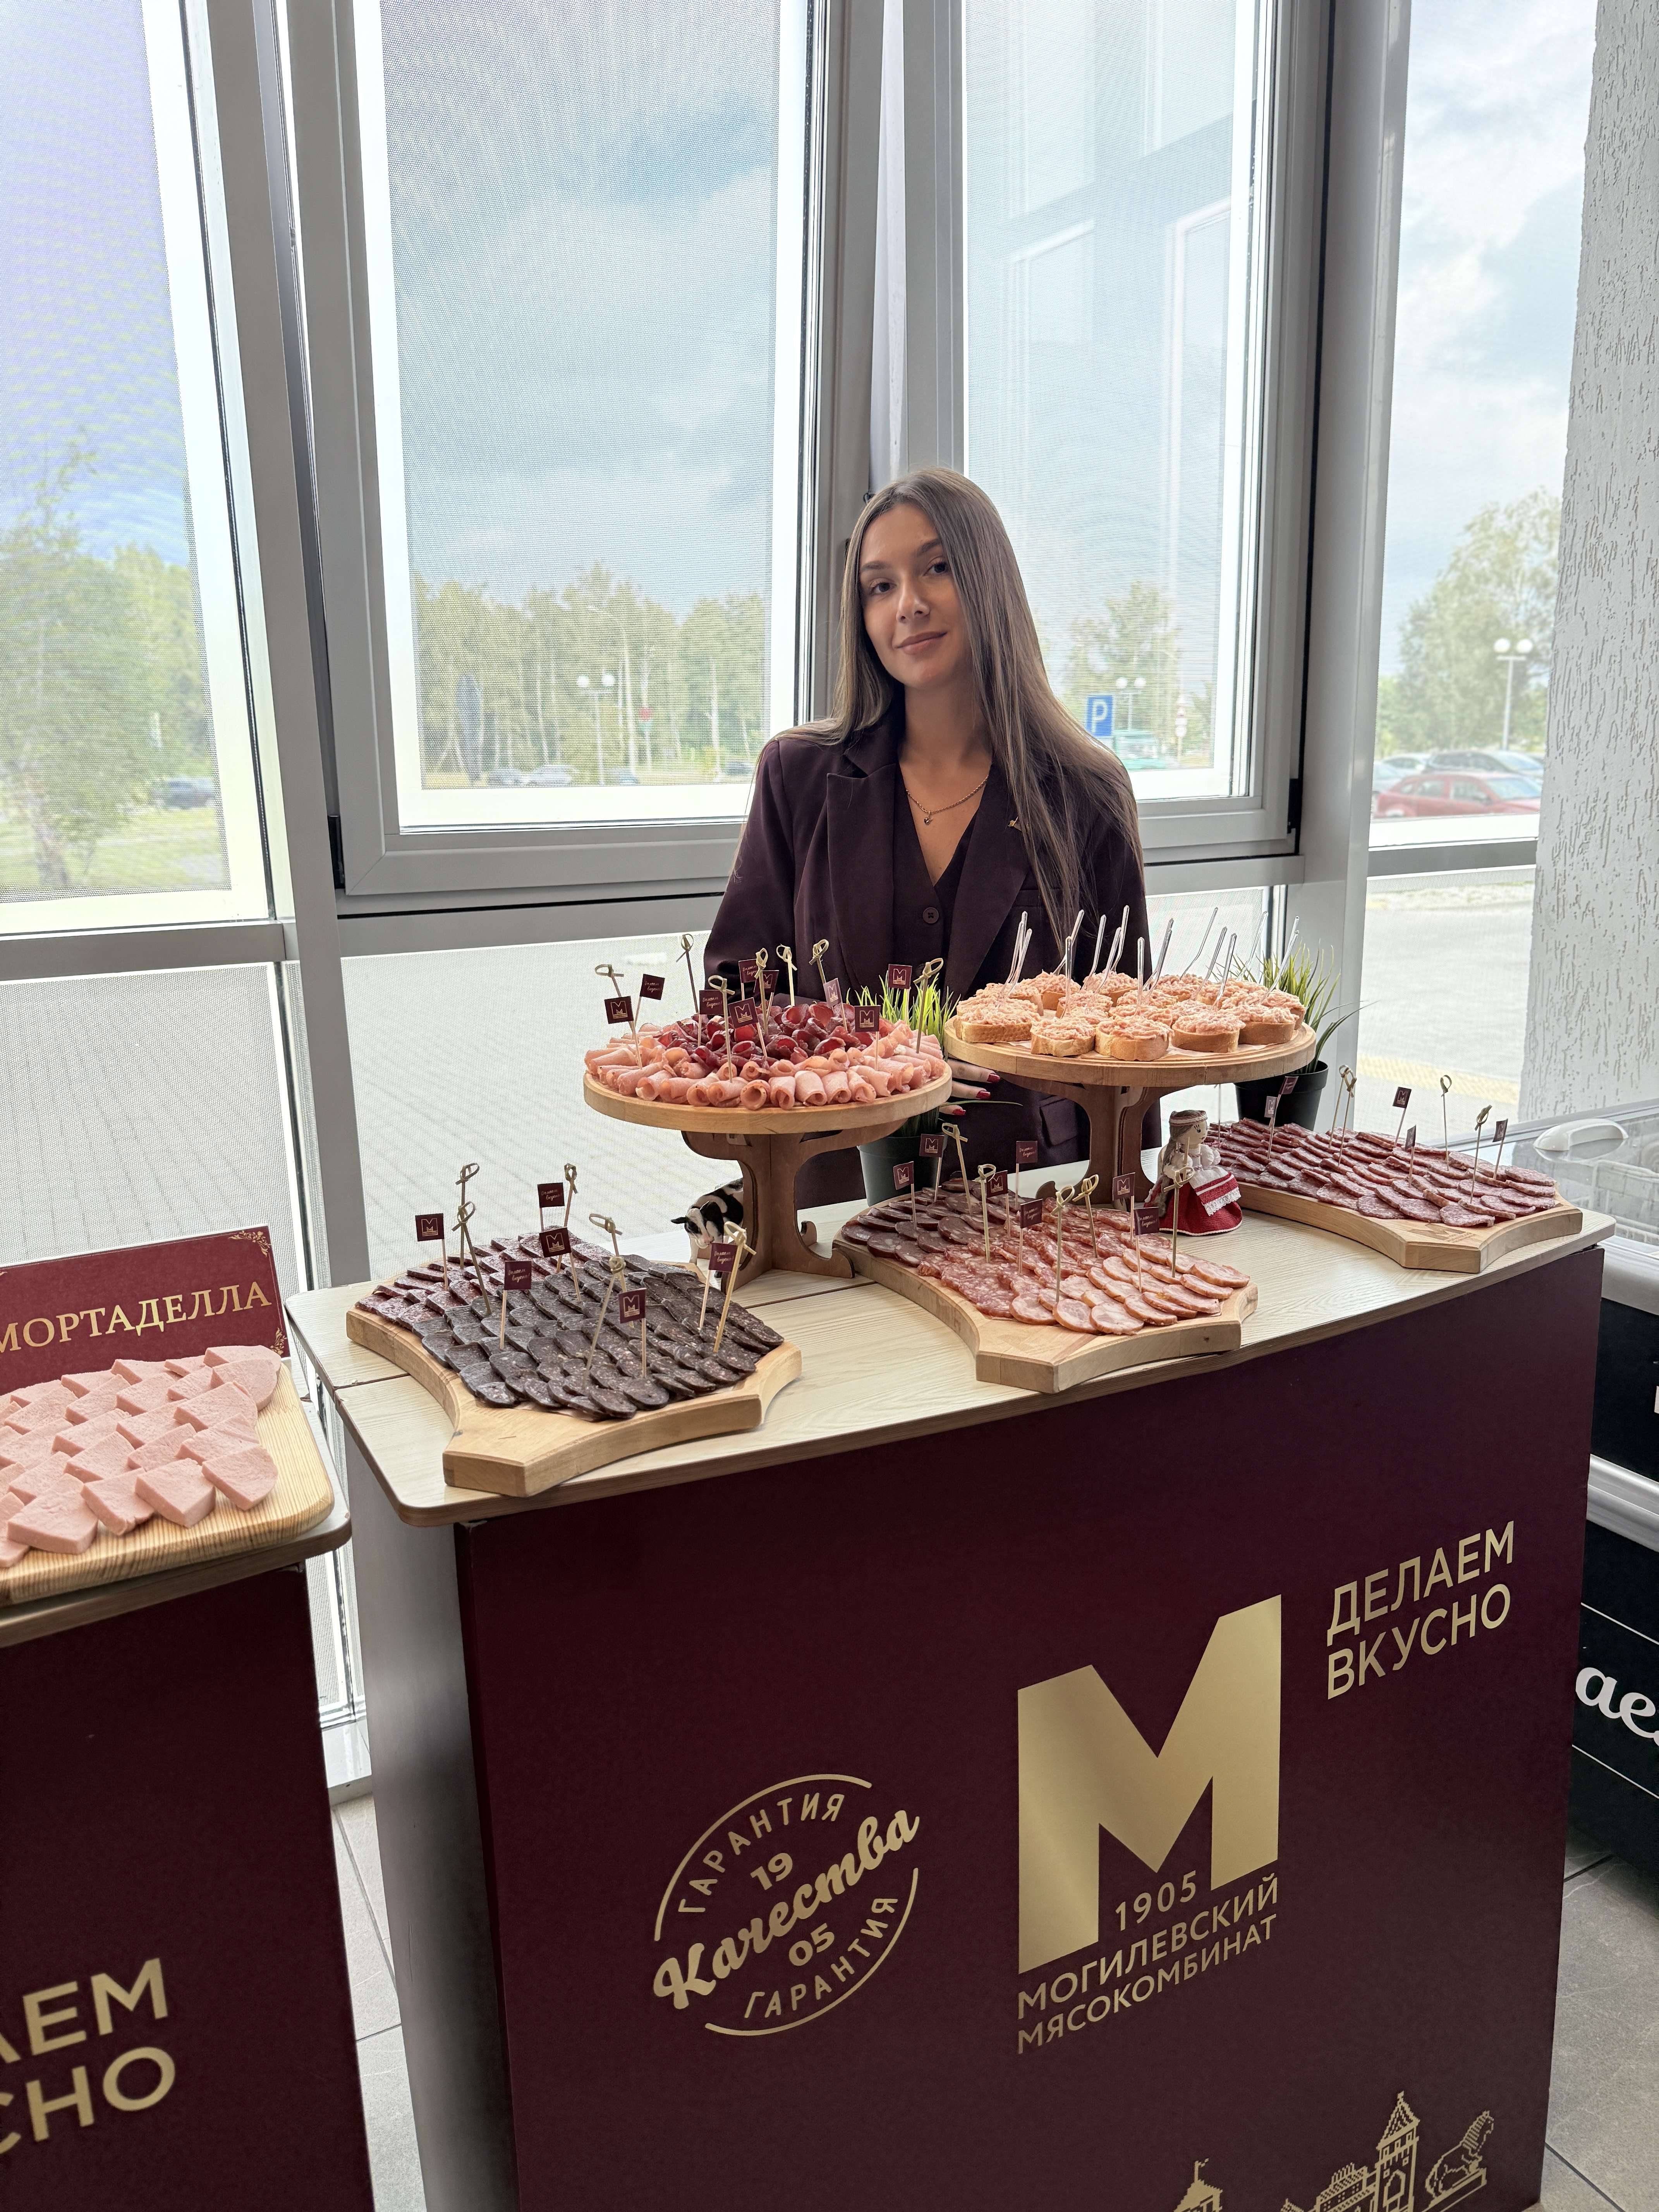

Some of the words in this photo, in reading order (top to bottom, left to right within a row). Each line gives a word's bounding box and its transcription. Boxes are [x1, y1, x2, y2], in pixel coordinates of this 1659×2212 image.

[1091, 700, 1108, 732] P
[1326, 1520, 1515, 1647] ДЕЛАЕМ
[1327, 1583, 1511, 1700] ВКУСНО
[1017, 1594, 1282, 1974] М
[653, 1810, 920, 2009] Качества
[678, 1793, 845, 1913] ГАРАНТИЯ
[750, 1852, 794, 1890] 19
[1115, 1870, 1196, 1931] 1905
[744, 1896, 898, 2019] ГАРАНТИЯ
[788, 1922, 835, 1966] 05
[1017, 1872, 1278, 2020] МОГИЛЕВСКИЙ
[1017, 1914, 1277, 2054] МЯСОКОМБИНАТ
[0, 1957, 168, 2063] ЕМ
